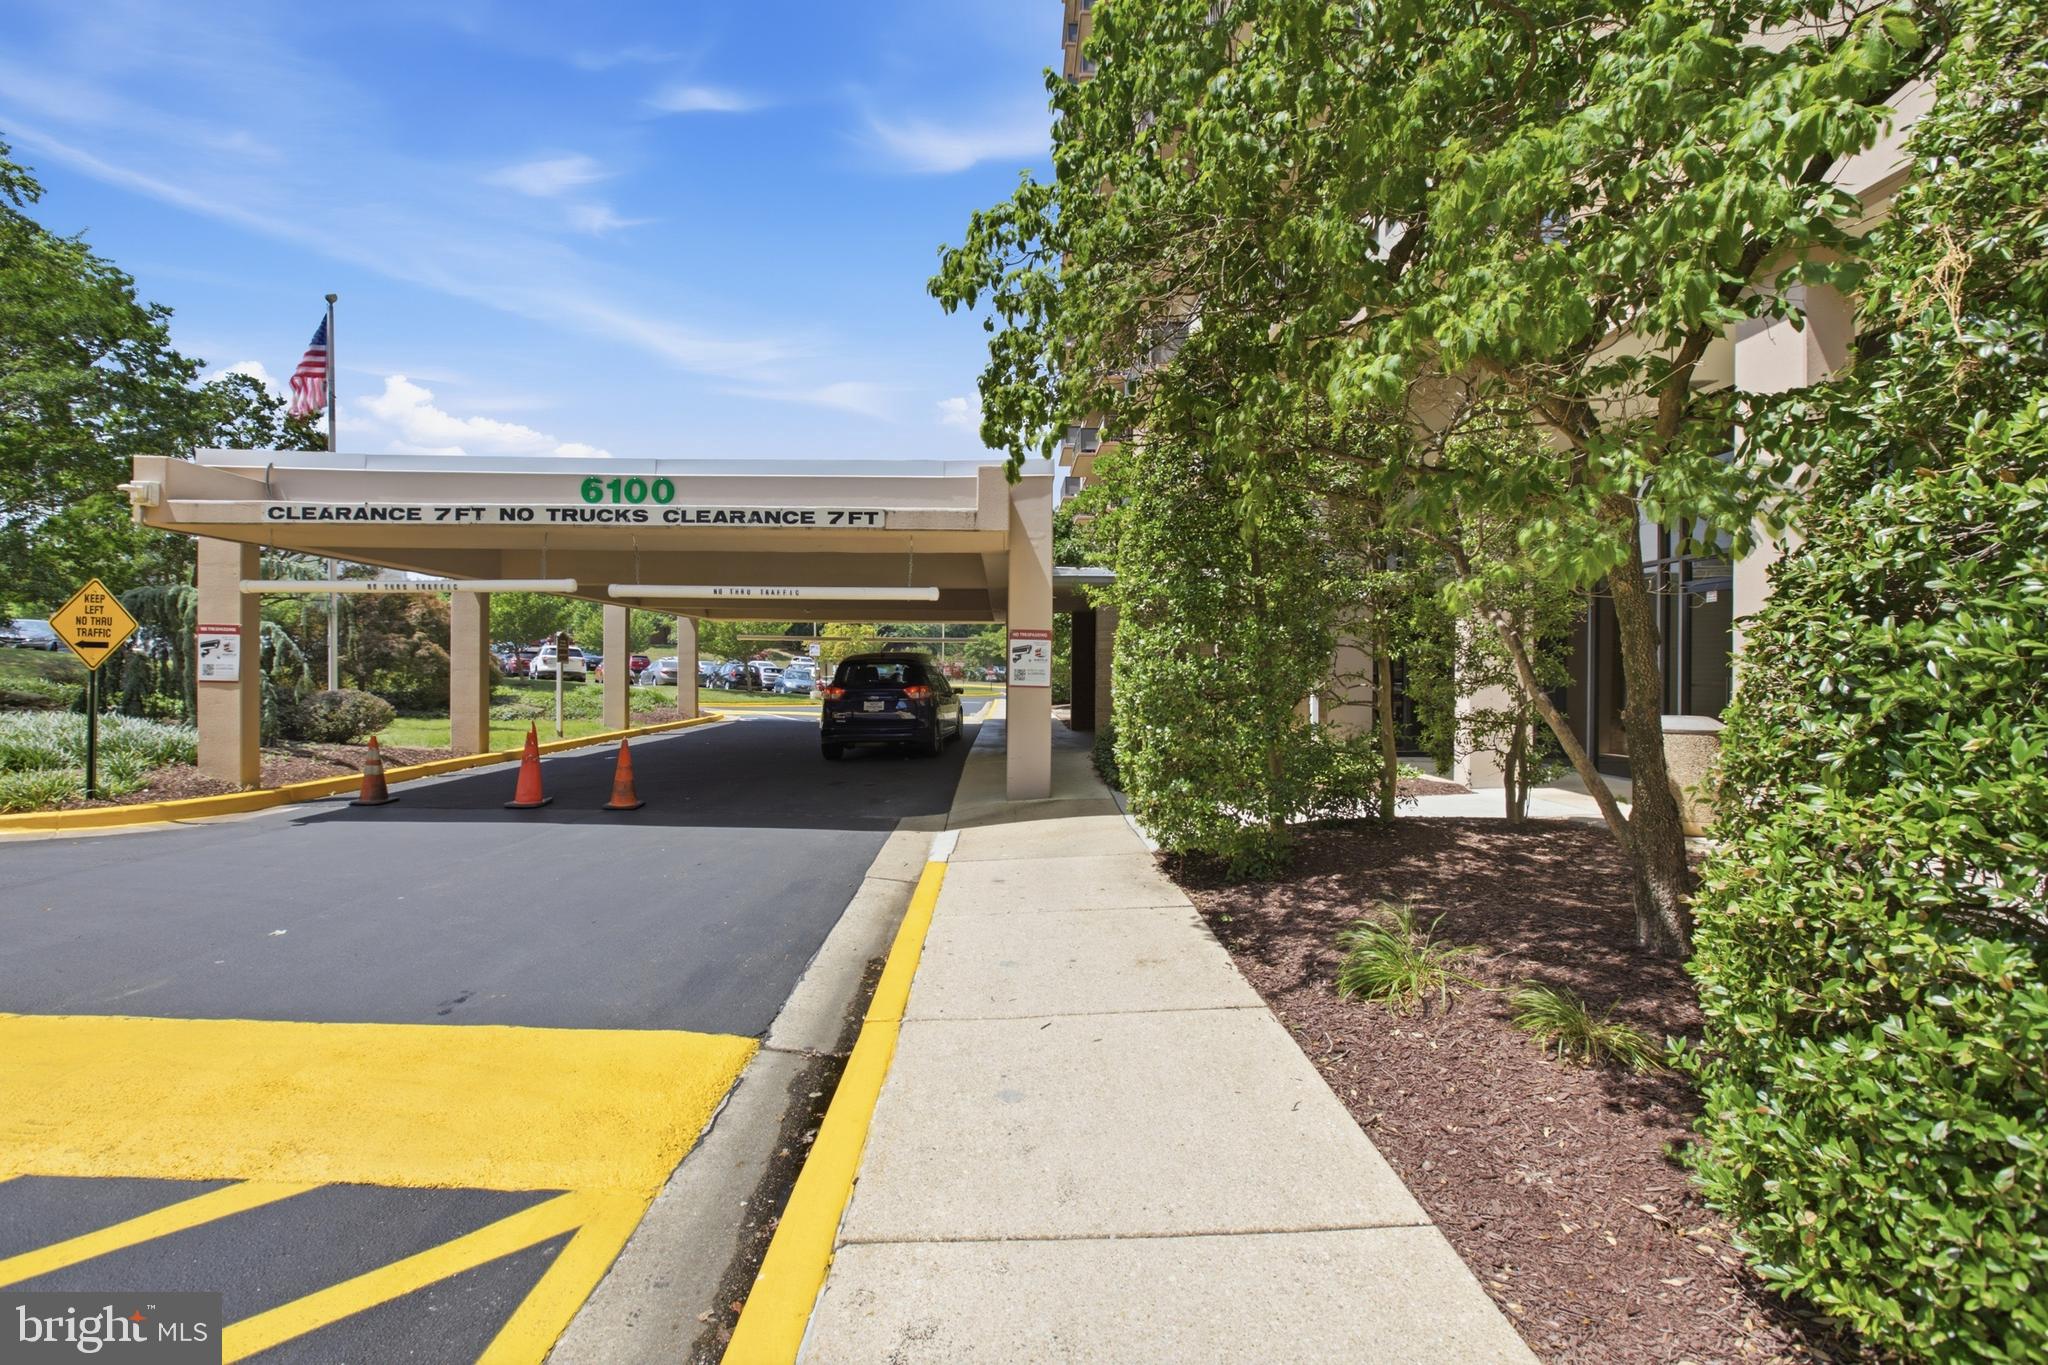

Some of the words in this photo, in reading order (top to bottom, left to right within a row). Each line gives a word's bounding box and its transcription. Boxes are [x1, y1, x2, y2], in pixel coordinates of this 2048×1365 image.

[581, 477, 675, 504] 6100
[267, 506, 422, 521] CLEARANCE
[500, 508, 535, 522] NO
[546, 508, 649, 523] TRUCKS
[662, 509, 816, 525] CLEARANCE
[760, 588, 799, 596] TRAFFIC
[84, 594, 106, 604] KEEP
[85, 606, 104, 615] LEFT
[75, 616, 88, 626] NO
[90, 616, 113, 626] THRU
[77, 628, 112, 638] TRAFFIC
